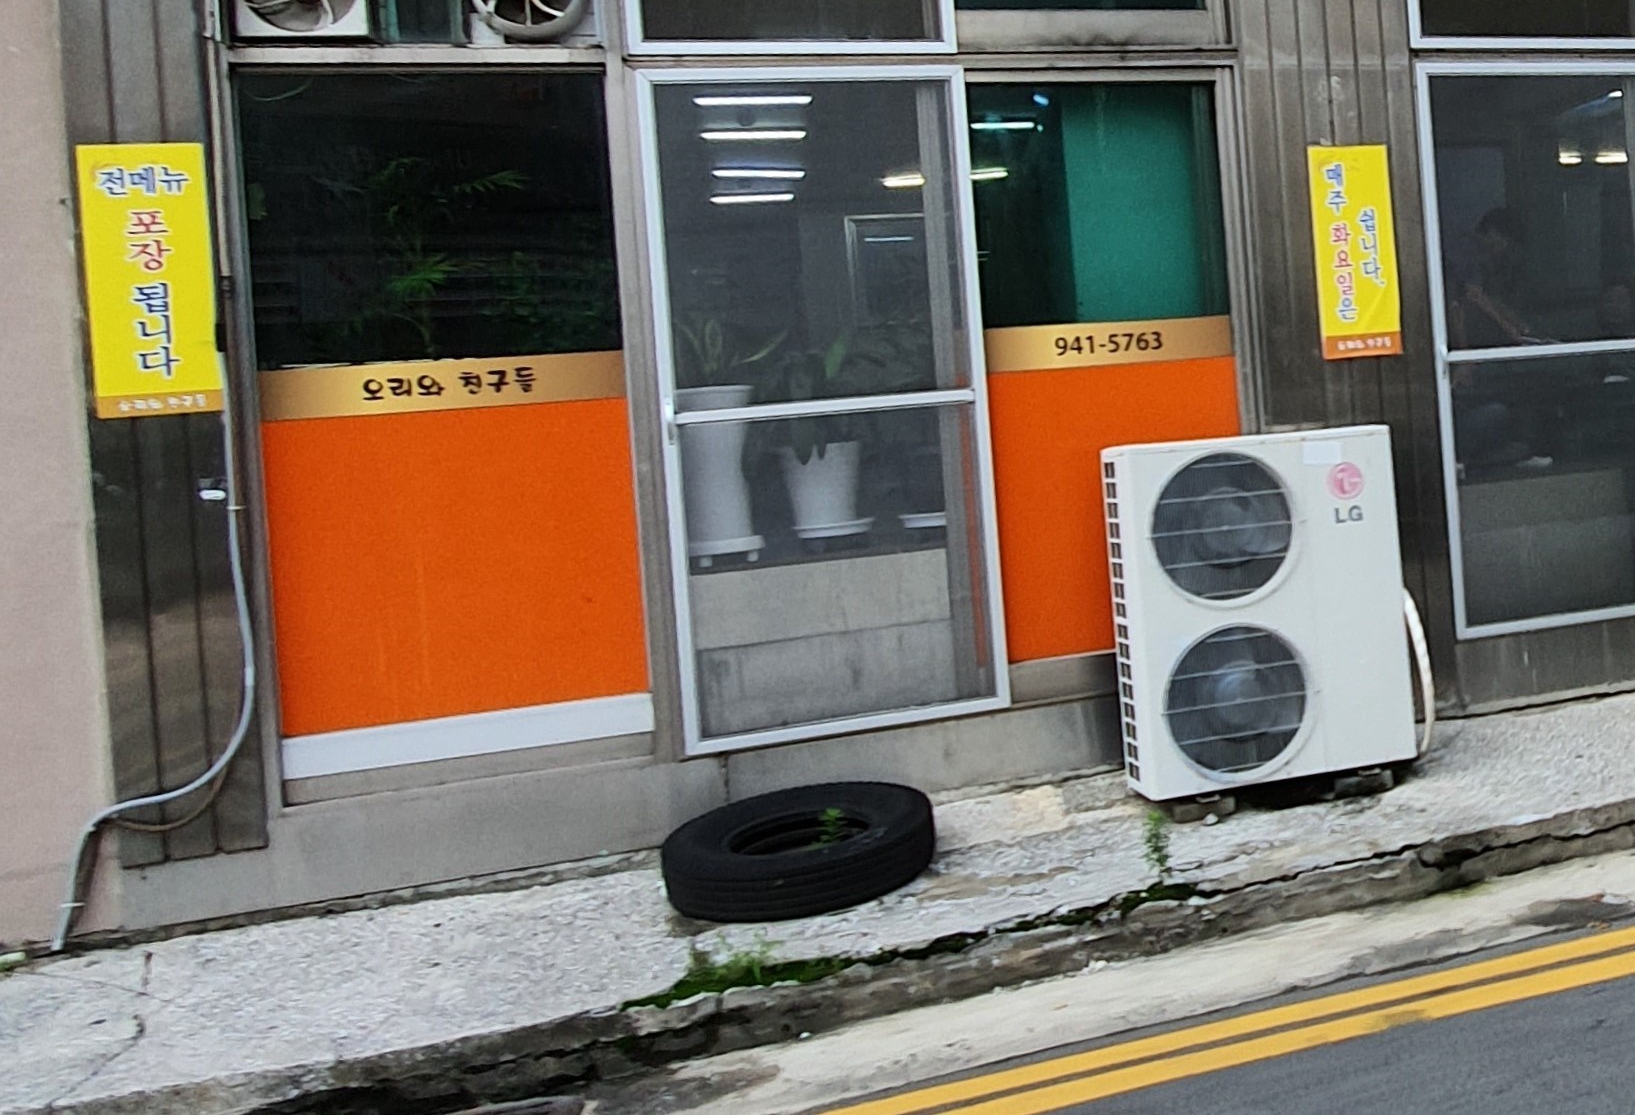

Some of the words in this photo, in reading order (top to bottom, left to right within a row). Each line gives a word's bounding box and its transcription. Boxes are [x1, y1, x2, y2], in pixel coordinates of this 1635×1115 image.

[96, 166, 190, 197] 전메뉴
[127, 209, 172, 272] 포장
[133, 282, 180, 379] 됩니다
[1054, 330, 1164, 357] 941-5763
[362, 373, 445, 401] 오리와
[459, 366, 537, 396] 친구들
[1333, 504, 1364, 525] LG
